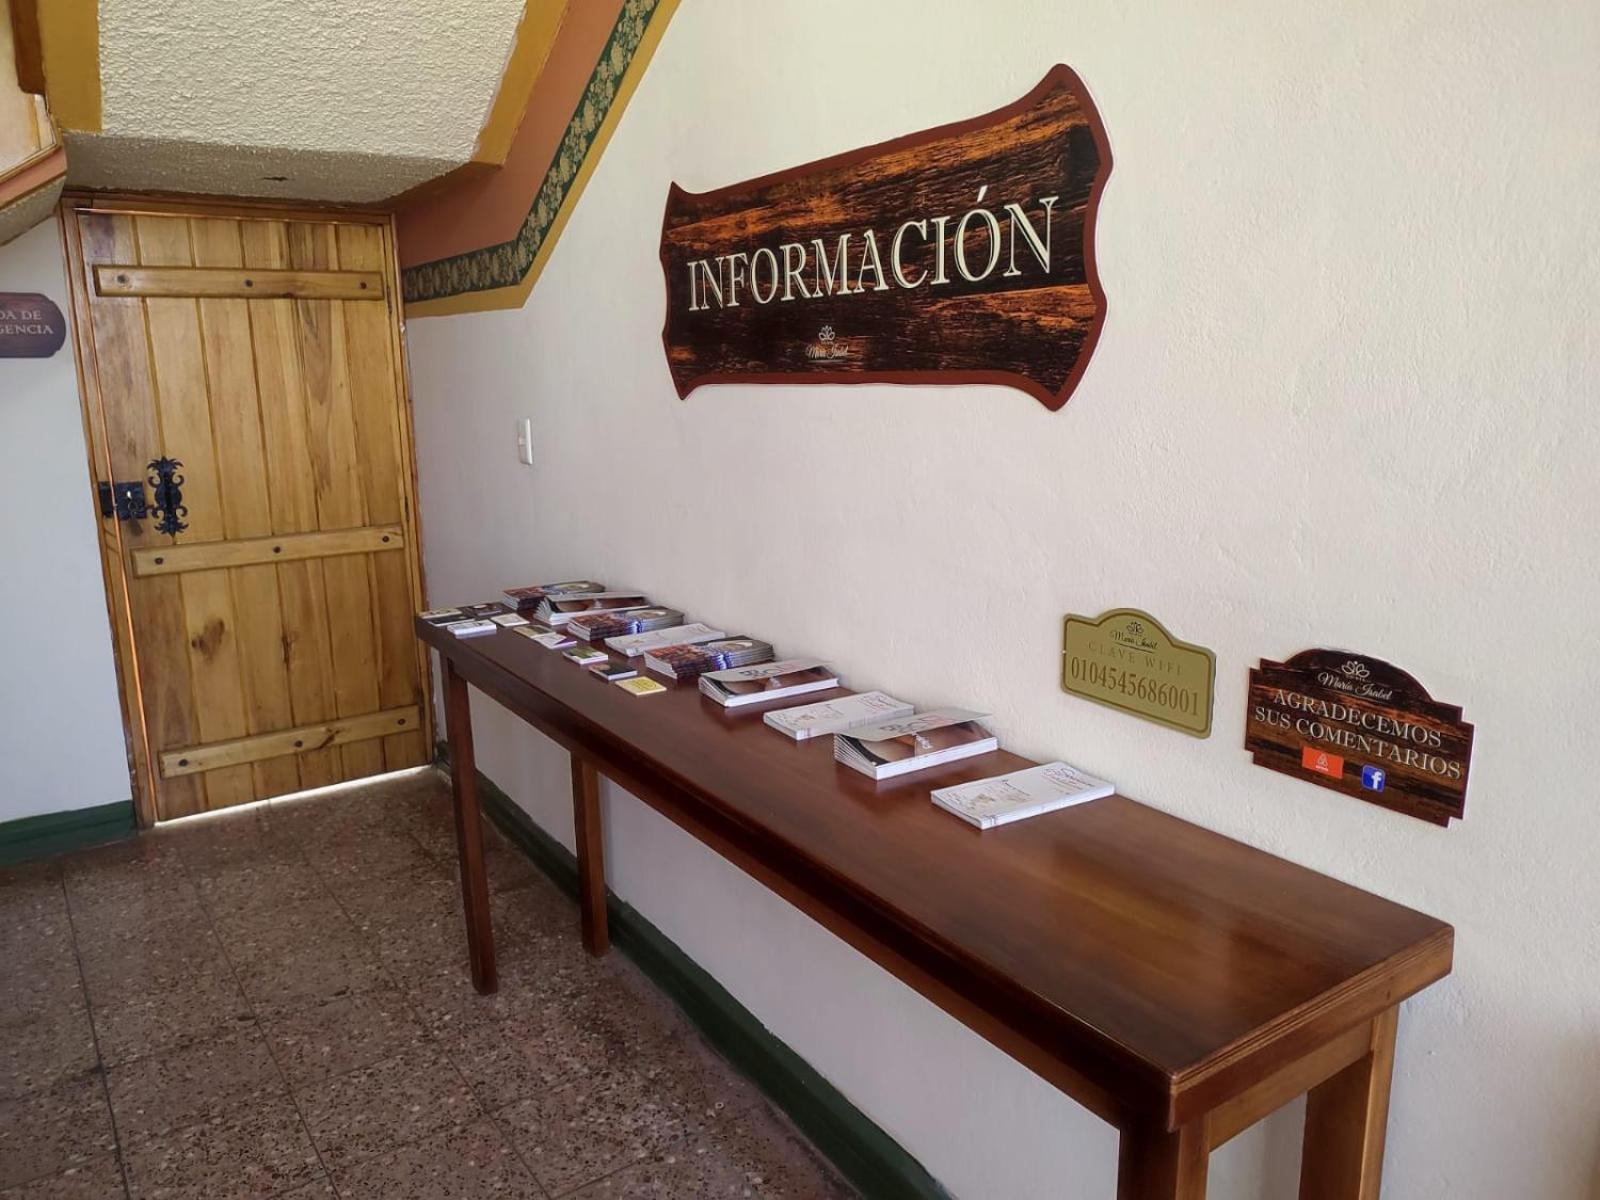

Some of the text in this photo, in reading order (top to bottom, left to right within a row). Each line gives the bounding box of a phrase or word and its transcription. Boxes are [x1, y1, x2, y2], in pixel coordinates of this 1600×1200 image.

[687, 186, 1059, 311] INFORMACIÓN
[22, 311, 42, 320] DE
[1071, 656, 1199, 716] 0104545686001
[1254, 706, 1462, 780] SUS COMENTARIOS
[1274, 689, 1442, 748] AGRADECEMOS
